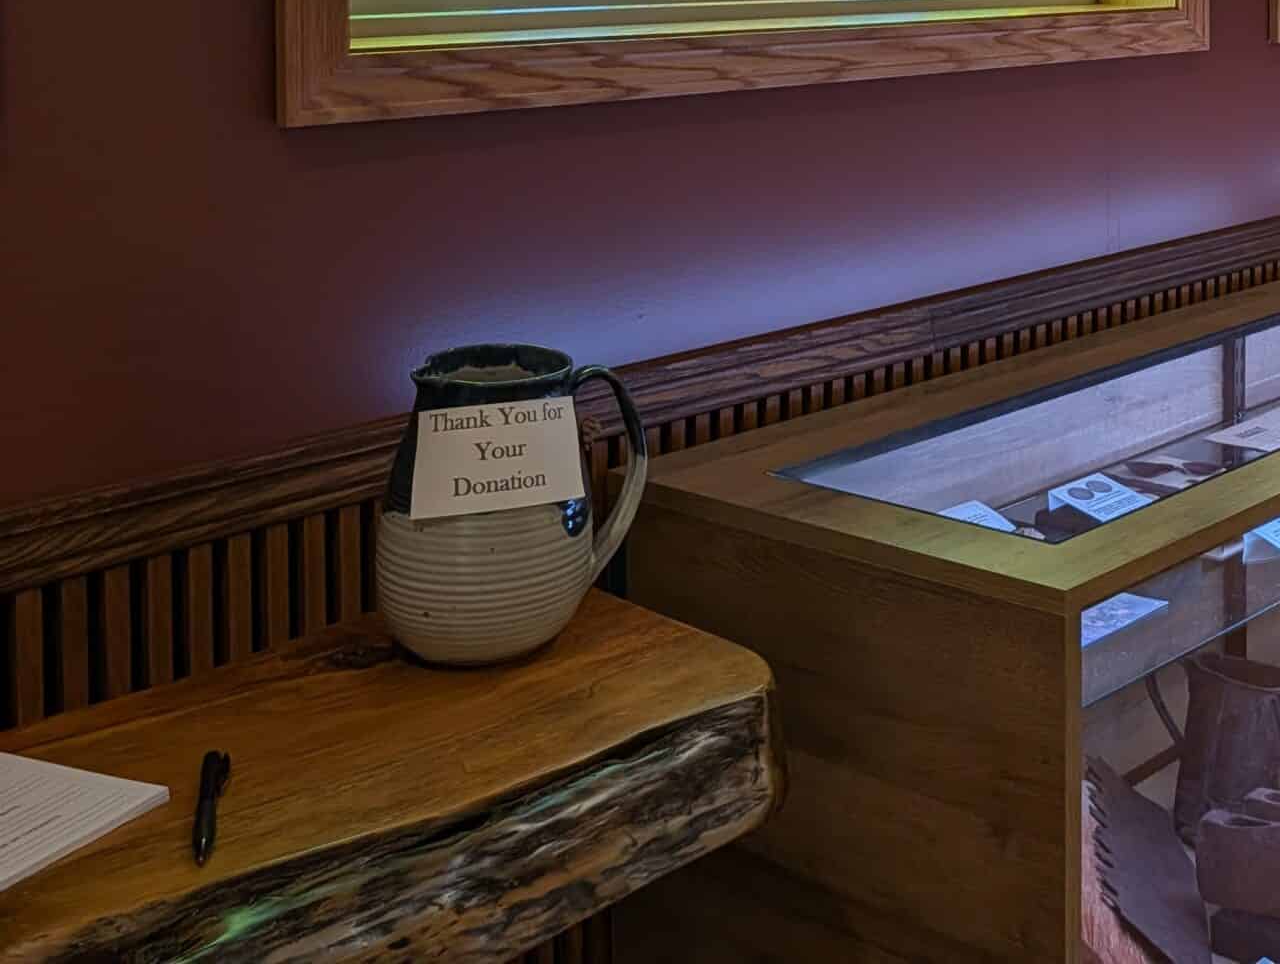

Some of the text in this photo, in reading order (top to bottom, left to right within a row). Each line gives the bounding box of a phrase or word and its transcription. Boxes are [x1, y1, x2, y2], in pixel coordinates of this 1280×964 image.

[429, 402, 564, 433] Thank You for
[472, 441, 528, 461] Your
[453, 470, 547, 498] Donation
